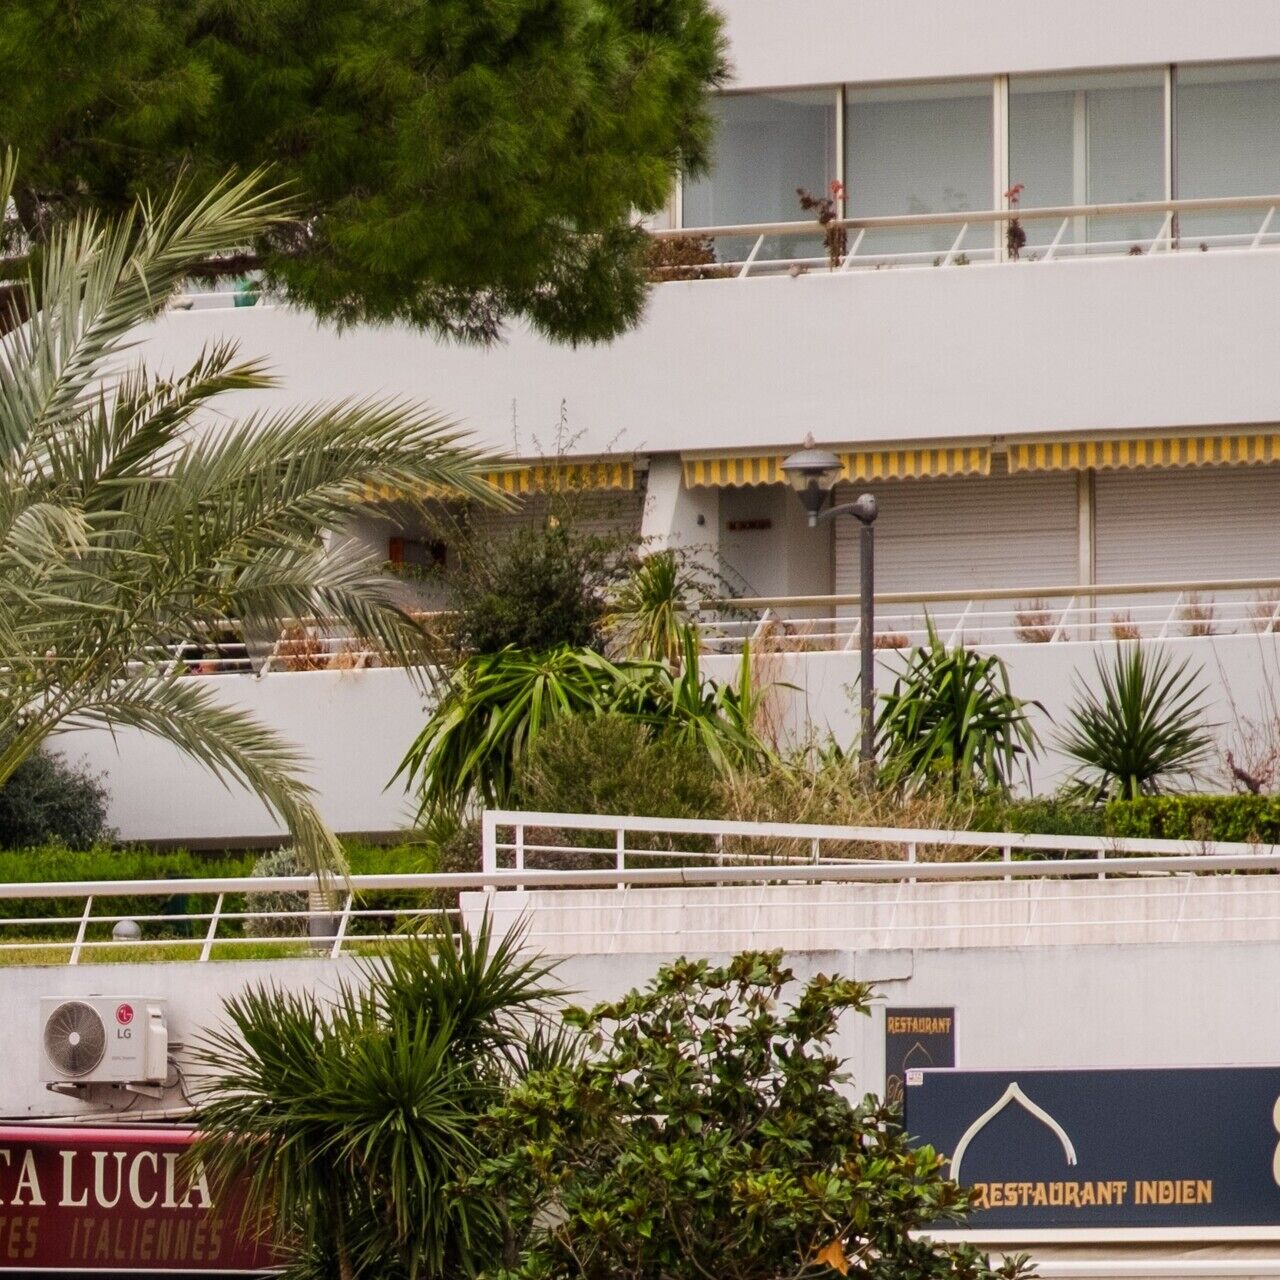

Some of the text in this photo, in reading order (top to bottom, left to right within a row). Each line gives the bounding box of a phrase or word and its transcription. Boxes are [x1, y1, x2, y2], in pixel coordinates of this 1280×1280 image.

[117, 1028, 132, 1039] LG
[887, 1016, 952, 1034] RESTAURANT
[58, 1149, 215, 1209] LUCIA
[973, 1179, 1213, 1209] RESTAURANT INDIEN
[69, 1215, 225, 1261] ITALIENNES
